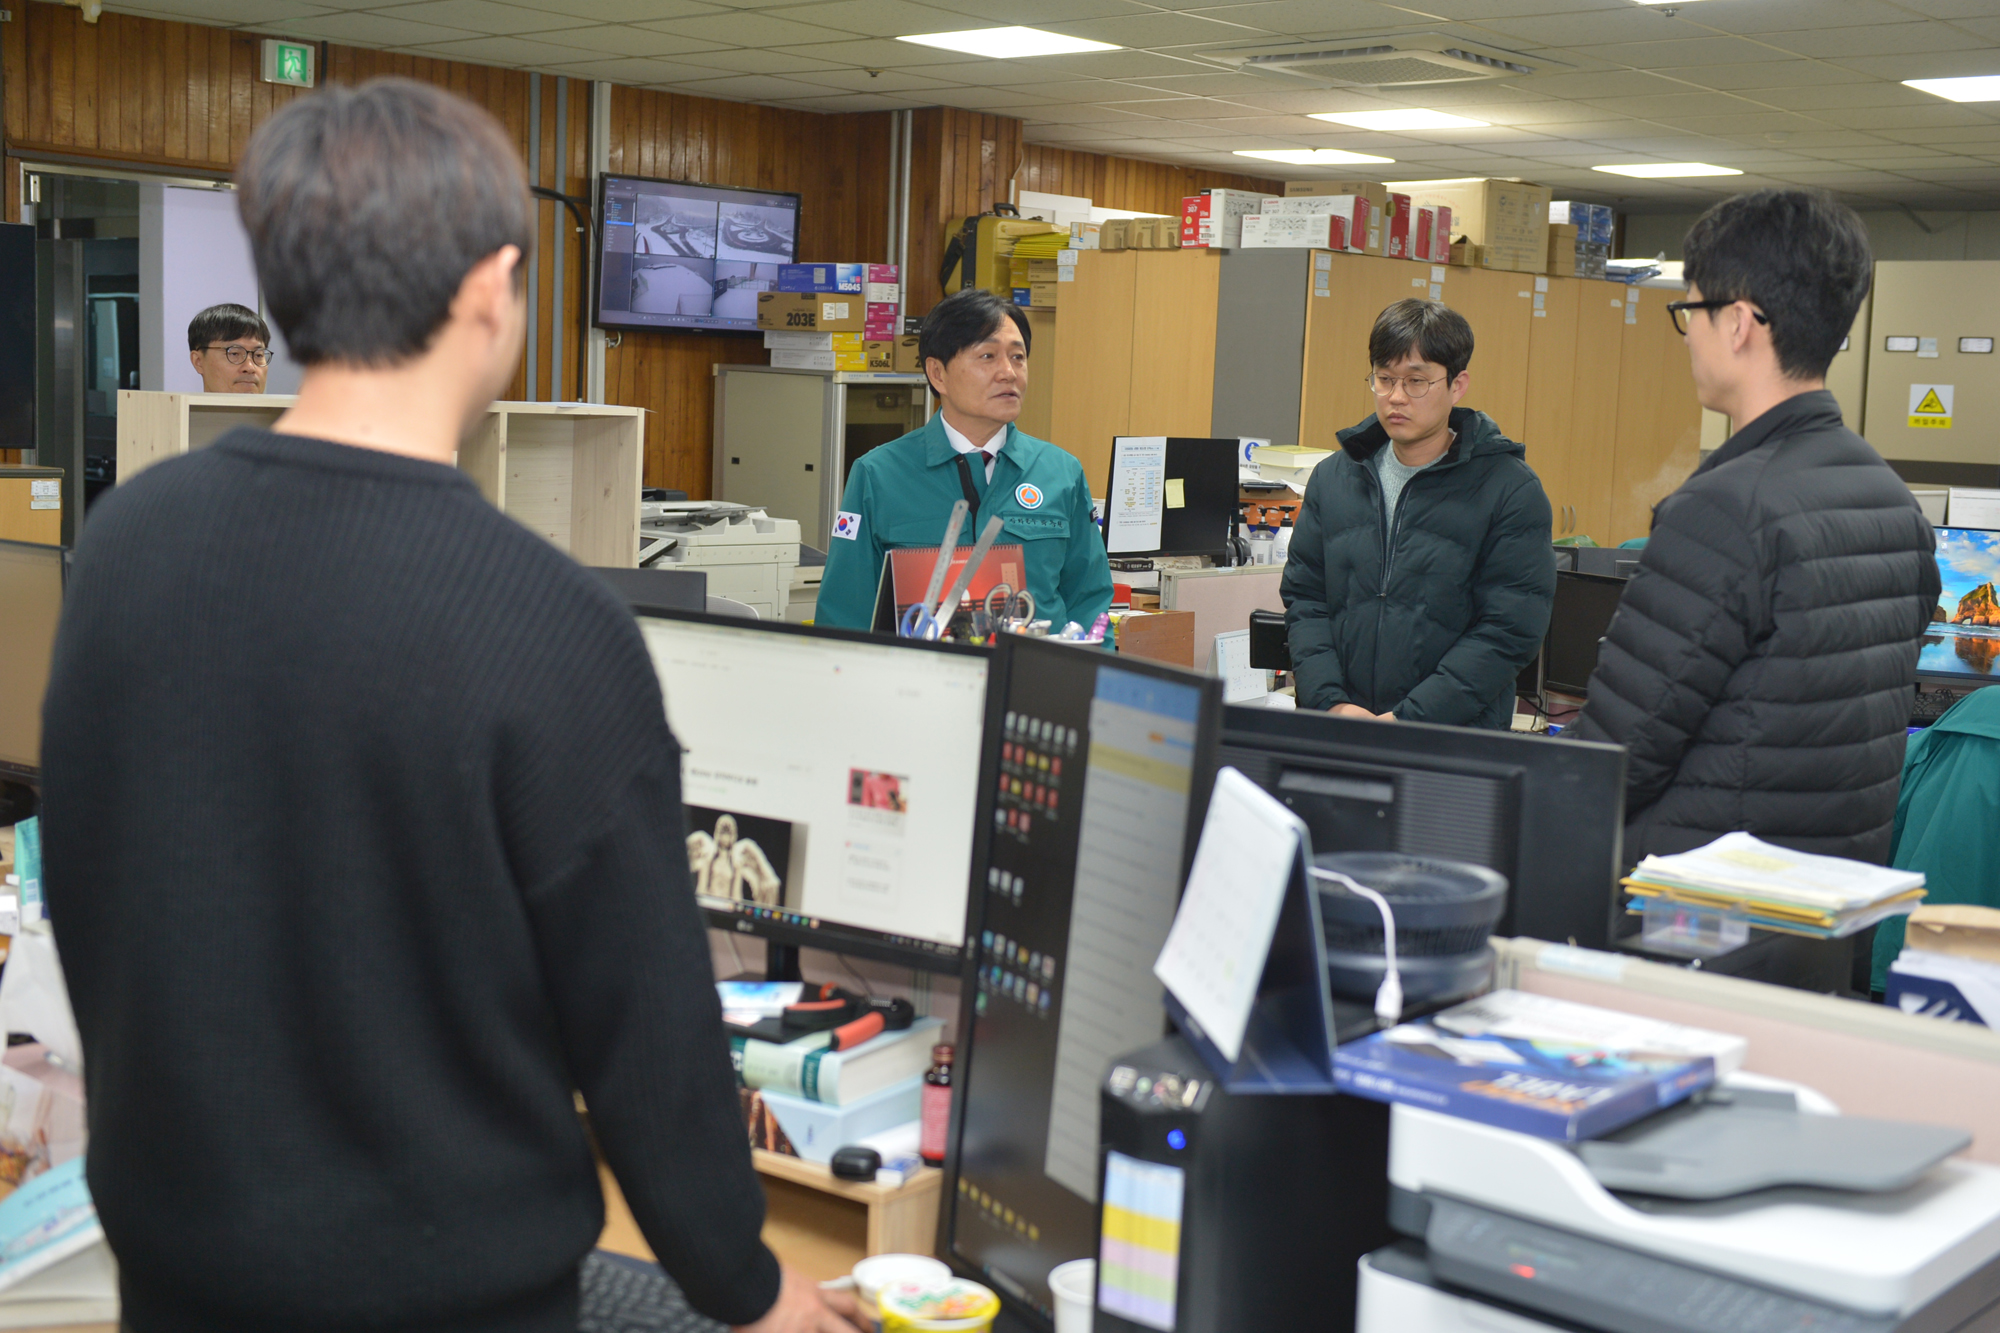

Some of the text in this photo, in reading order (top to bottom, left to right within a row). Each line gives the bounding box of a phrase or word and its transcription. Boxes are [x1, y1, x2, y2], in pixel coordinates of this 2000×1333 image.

[1187, 205, 1198, 213] 307
[838, 282, 861, 292] M504S
[786, 312, 816, 326] 203E
[870, 360, 890, 368] K506L
